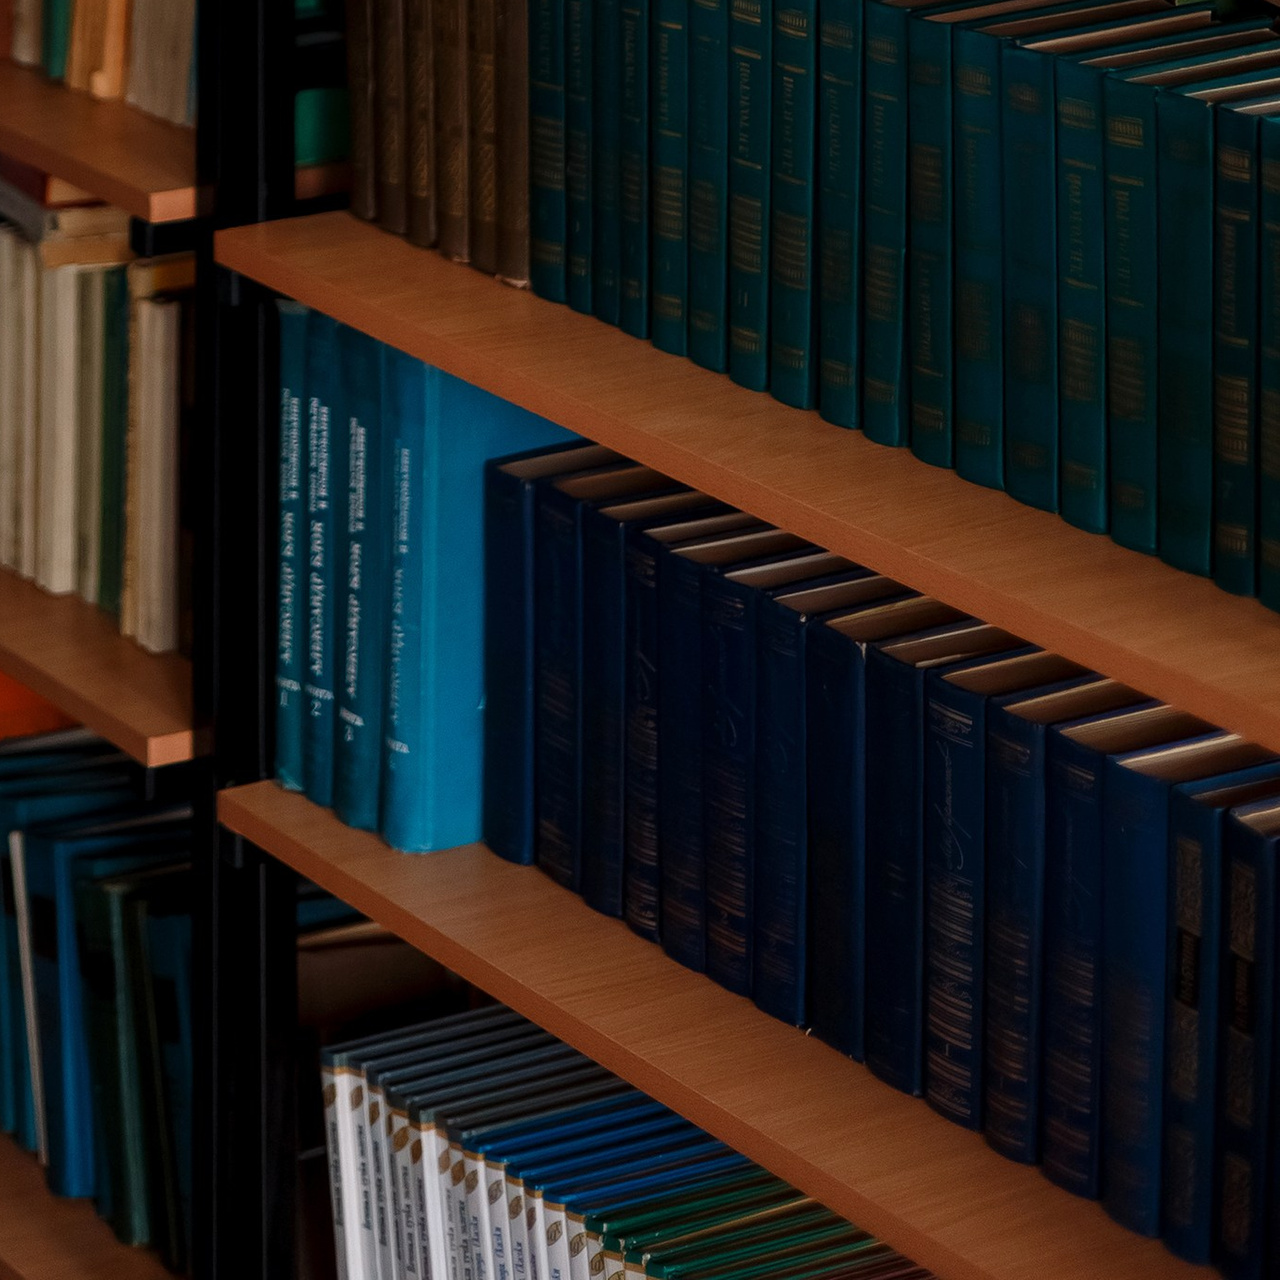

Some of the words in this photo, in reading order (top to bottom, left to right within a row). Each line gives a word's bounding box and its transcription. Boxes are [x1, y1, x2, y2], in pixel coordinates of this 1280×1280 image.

[280, 510, 295, 558] БЛОК
[309, 520, 325, 568] БЛОК
[347, 541, 361, 590] БЛОК
[311, 699, 322, 717] 2
